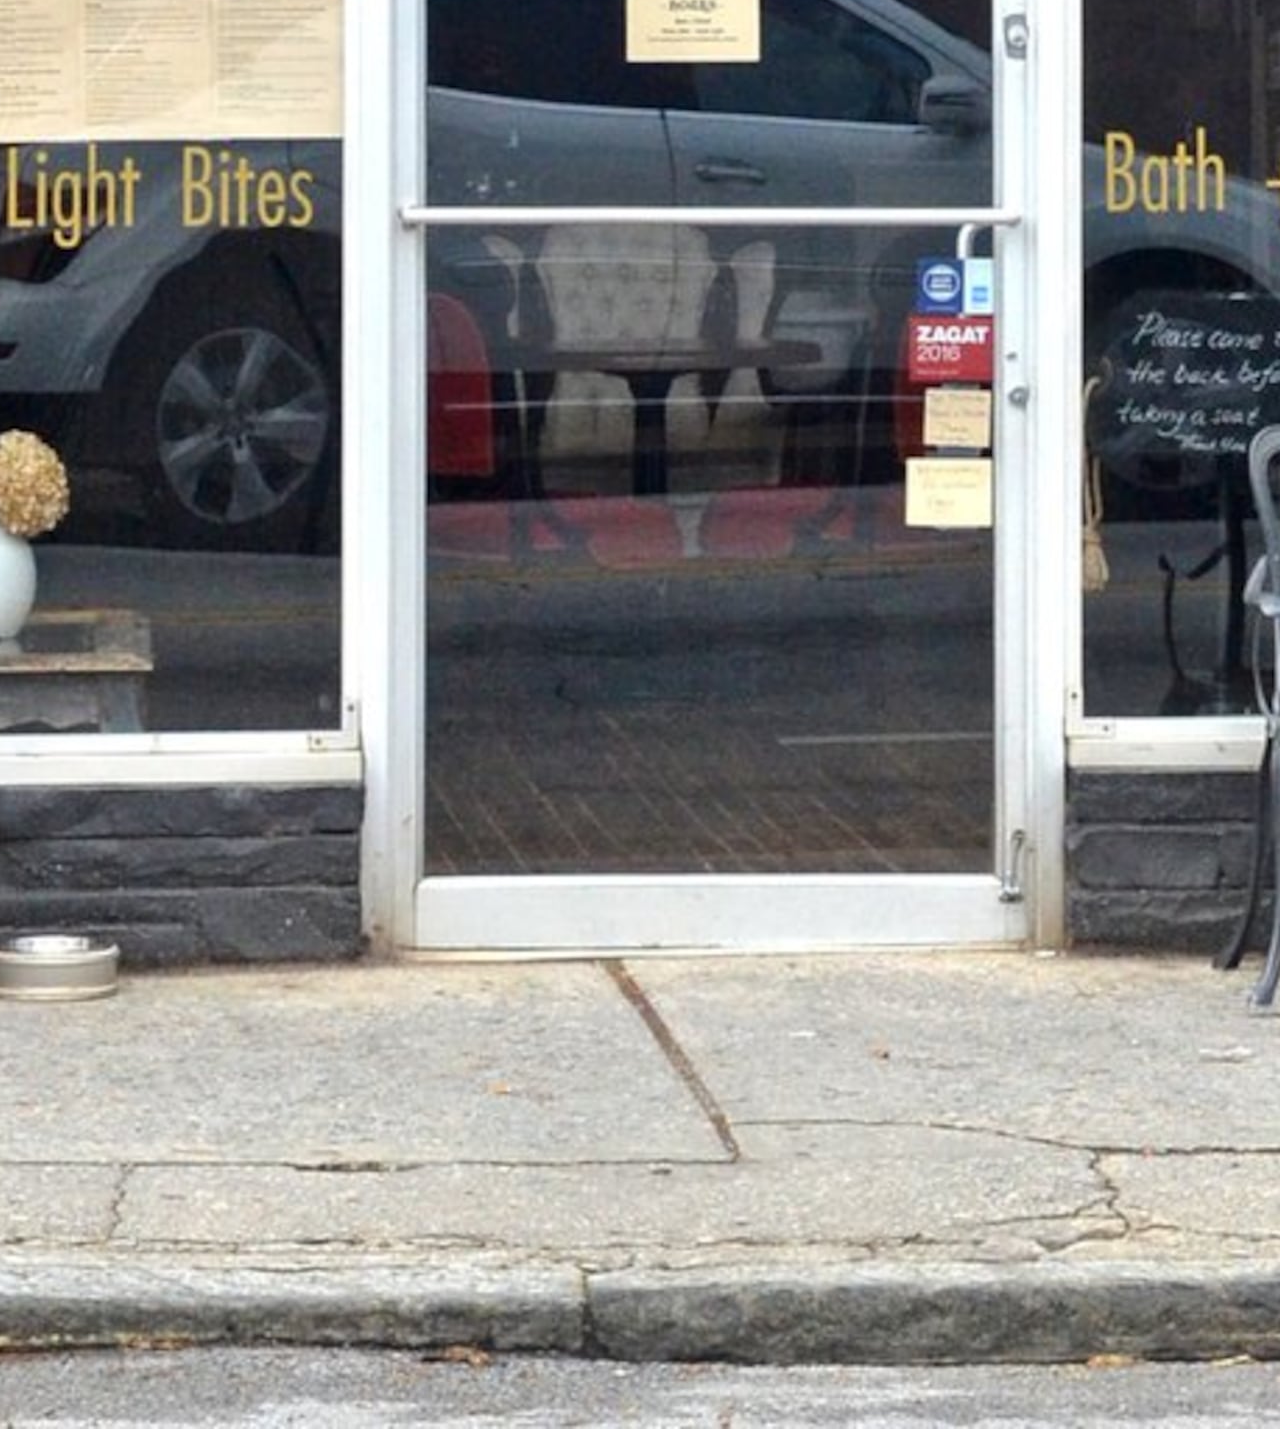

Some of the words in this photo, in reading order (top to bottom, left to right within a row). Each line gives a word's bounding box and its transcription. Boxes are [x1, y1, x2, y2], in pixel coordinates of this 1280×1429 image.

[1104, 127, 1226, 213] Bath
[6, 142, 140, 249] Light
[180, 144, 314, 228] Bites
[916, 325, 990, 344] ZAGAT
[1132, 311, 1204, 348] Please
[1208, 331, 1264, 350] come
[1127, 359, 1166, 384] the
[1173, 363, 1230, 384] back
[1190, 409, 1207, 426] a
